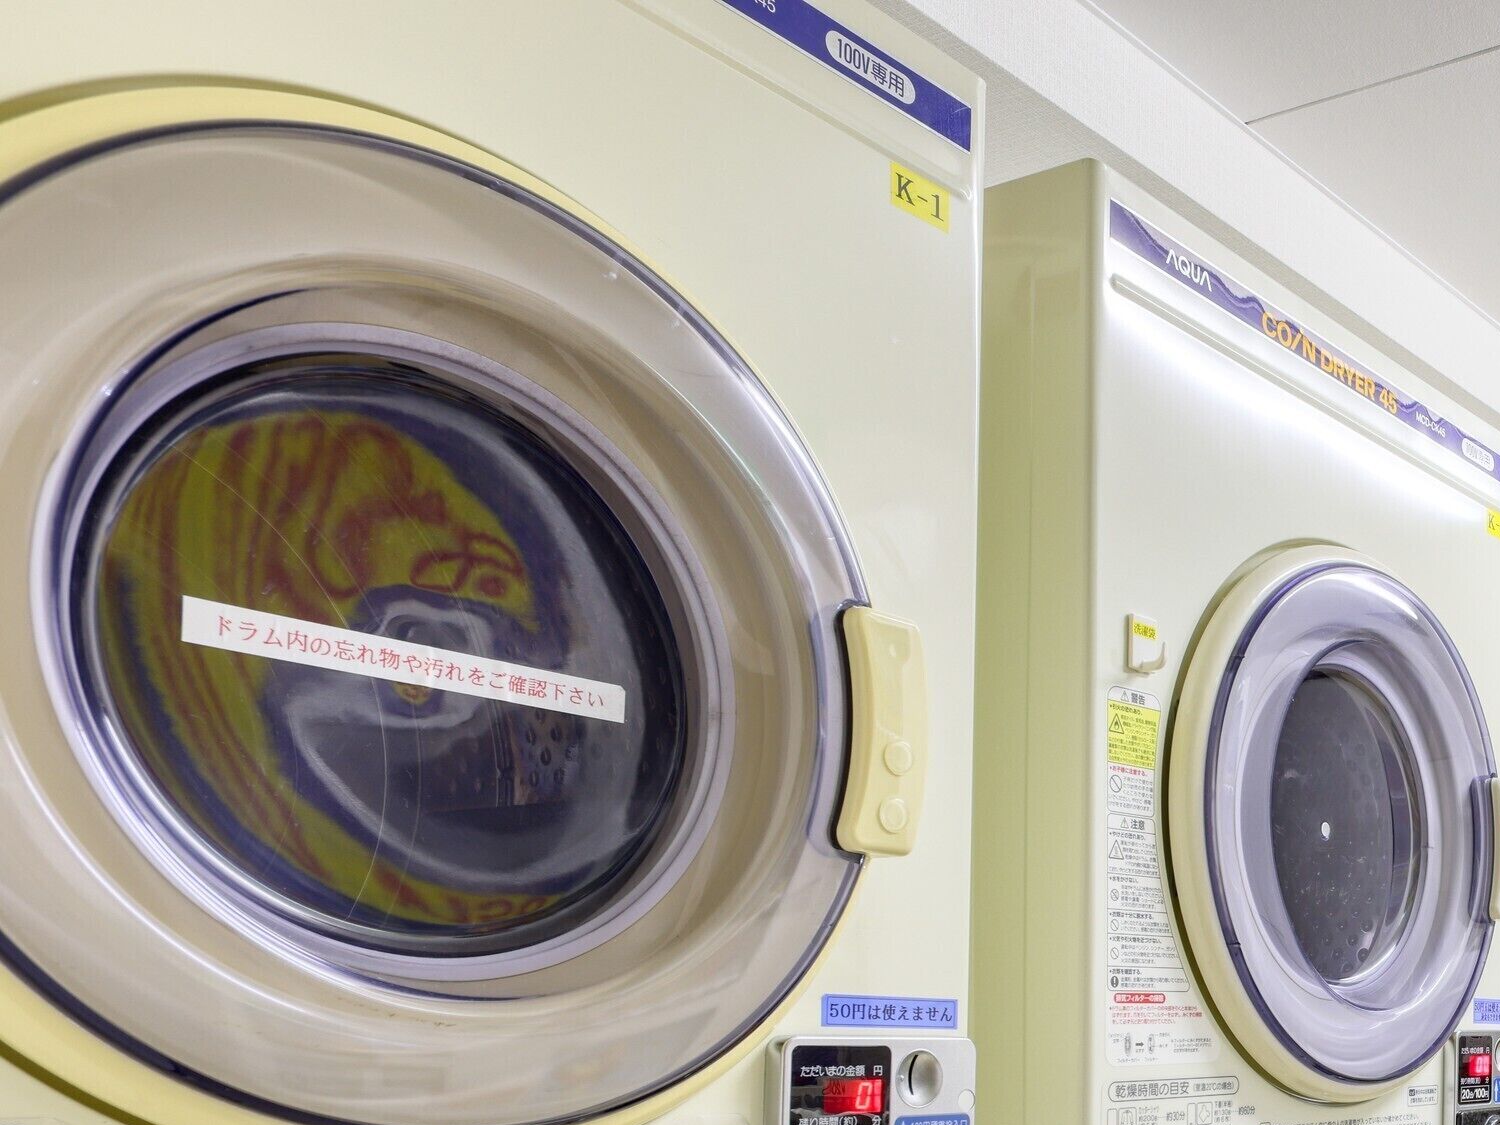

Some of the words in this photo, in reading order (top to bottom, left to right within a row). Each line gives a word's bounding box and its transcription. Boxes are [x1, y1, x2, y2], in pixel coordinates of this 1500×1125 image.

[837, 38, 904, 98] 100V専用
[895, 172, 944, 222] K-1
[1165, 249, 1213, 292] AQUA
[1320, 351, 1376, 401] DRYER
[1379, 387, 1398, 413] 45
[217, 615, 605, 709] ドラム内の忘れ物や汚れをご確認下さい
[829, 1003, 953, 1023] 50円は使えません
[800, 1065, 865, 1078] ただいまの金額
[873, 1065, 883, 1076] 円
[1115, 1082, 1190, 1098] 乾燥時間の目安
